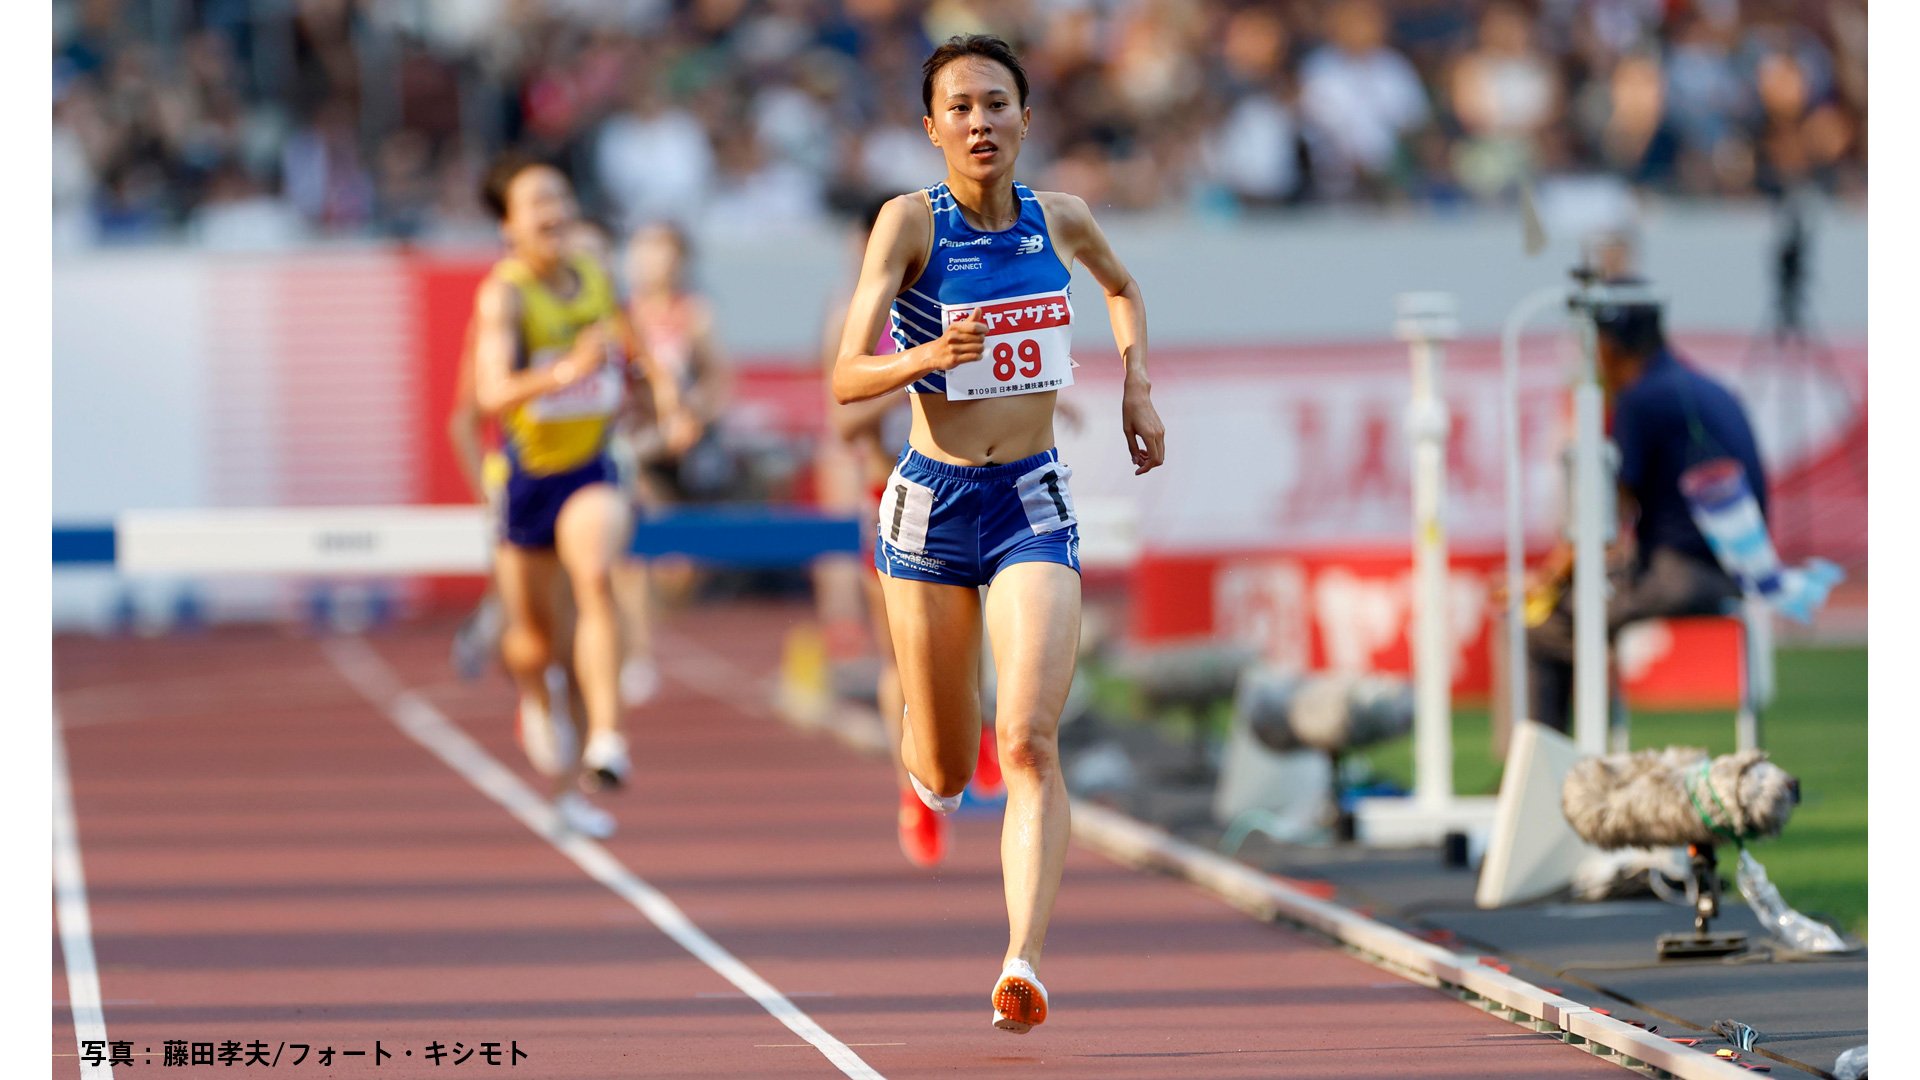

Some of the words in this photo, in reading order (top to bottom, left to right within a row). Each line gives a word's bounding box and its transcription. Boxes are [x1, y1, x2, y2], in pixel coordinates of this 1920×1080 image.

[939, 235, 992, 248] Panasonic
[946, 262, 982, 272] CONNECT
[948, 256, 980, 264] Panasonic
[983, 303, 1066, 330] ヤマザキ
[993, 339, 1042, 381] 89
[1039, 469, 1069, 522] 1
[890, 484, 908, 542] 1
